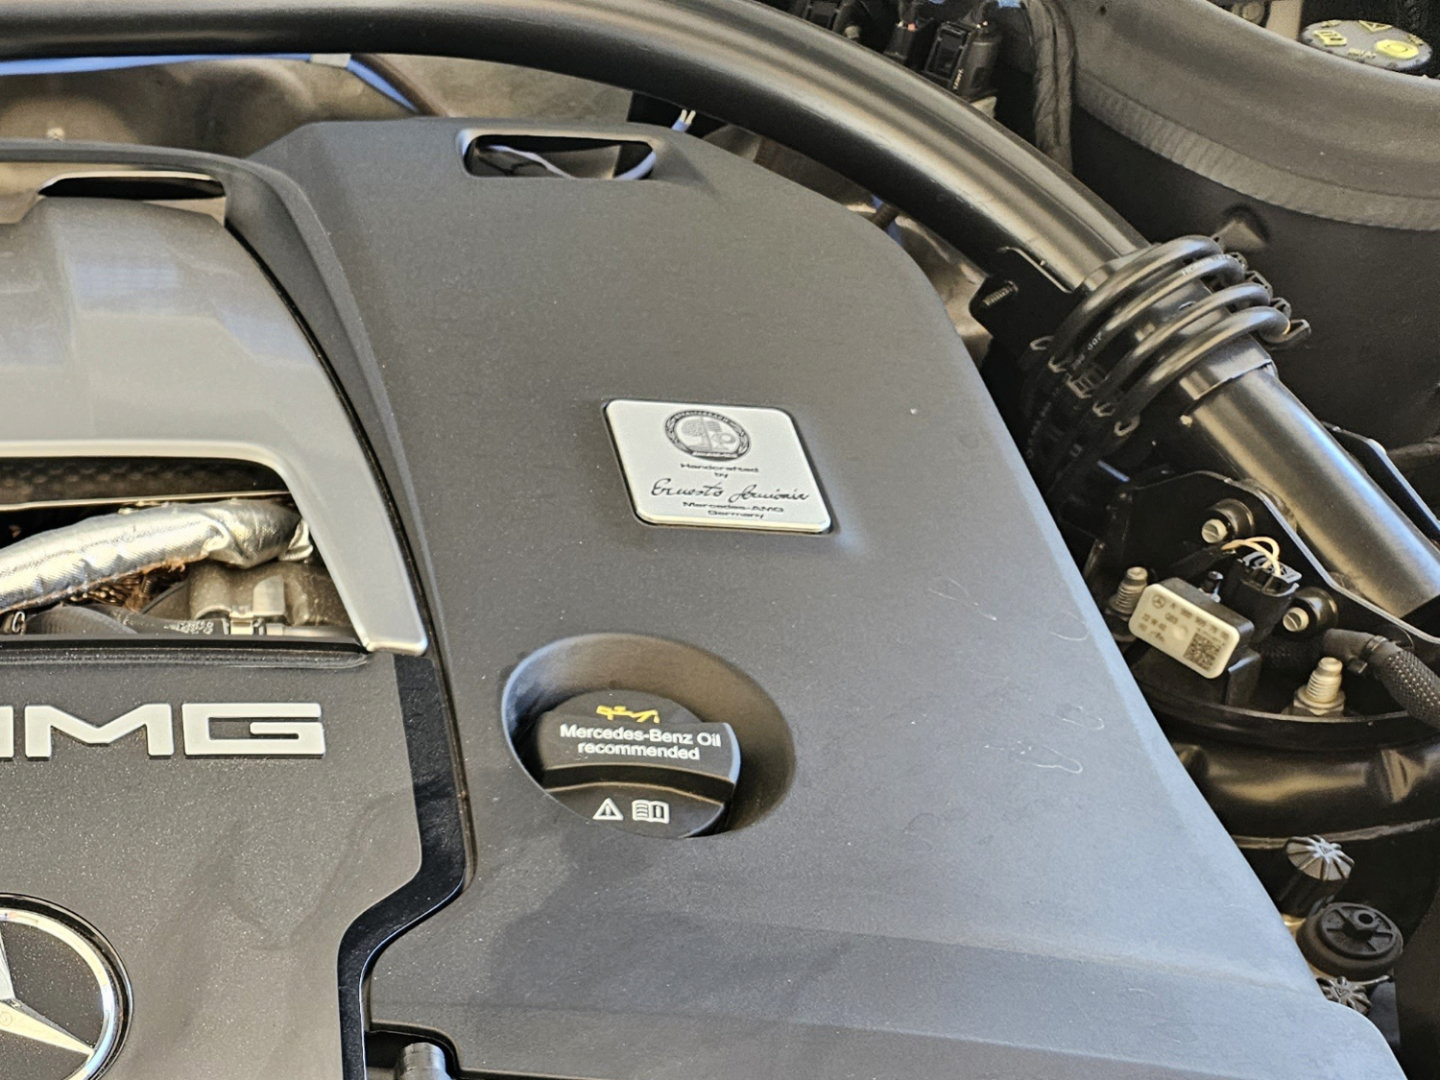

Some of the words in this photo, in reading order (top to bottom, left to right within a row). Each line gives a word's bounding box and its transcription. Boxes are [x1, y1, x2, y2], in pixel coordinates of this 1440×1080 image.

[680, 463, 759, 472] Handcrafted
[682, 501, 784, 512] Mercedes-AMG
[707, 510, 764, 519] Germany
[560, 723, 693, 745] Mercedes-Benz
[696, 732, 722, 747] Oil
[577, 742, 700, 760] recommended
